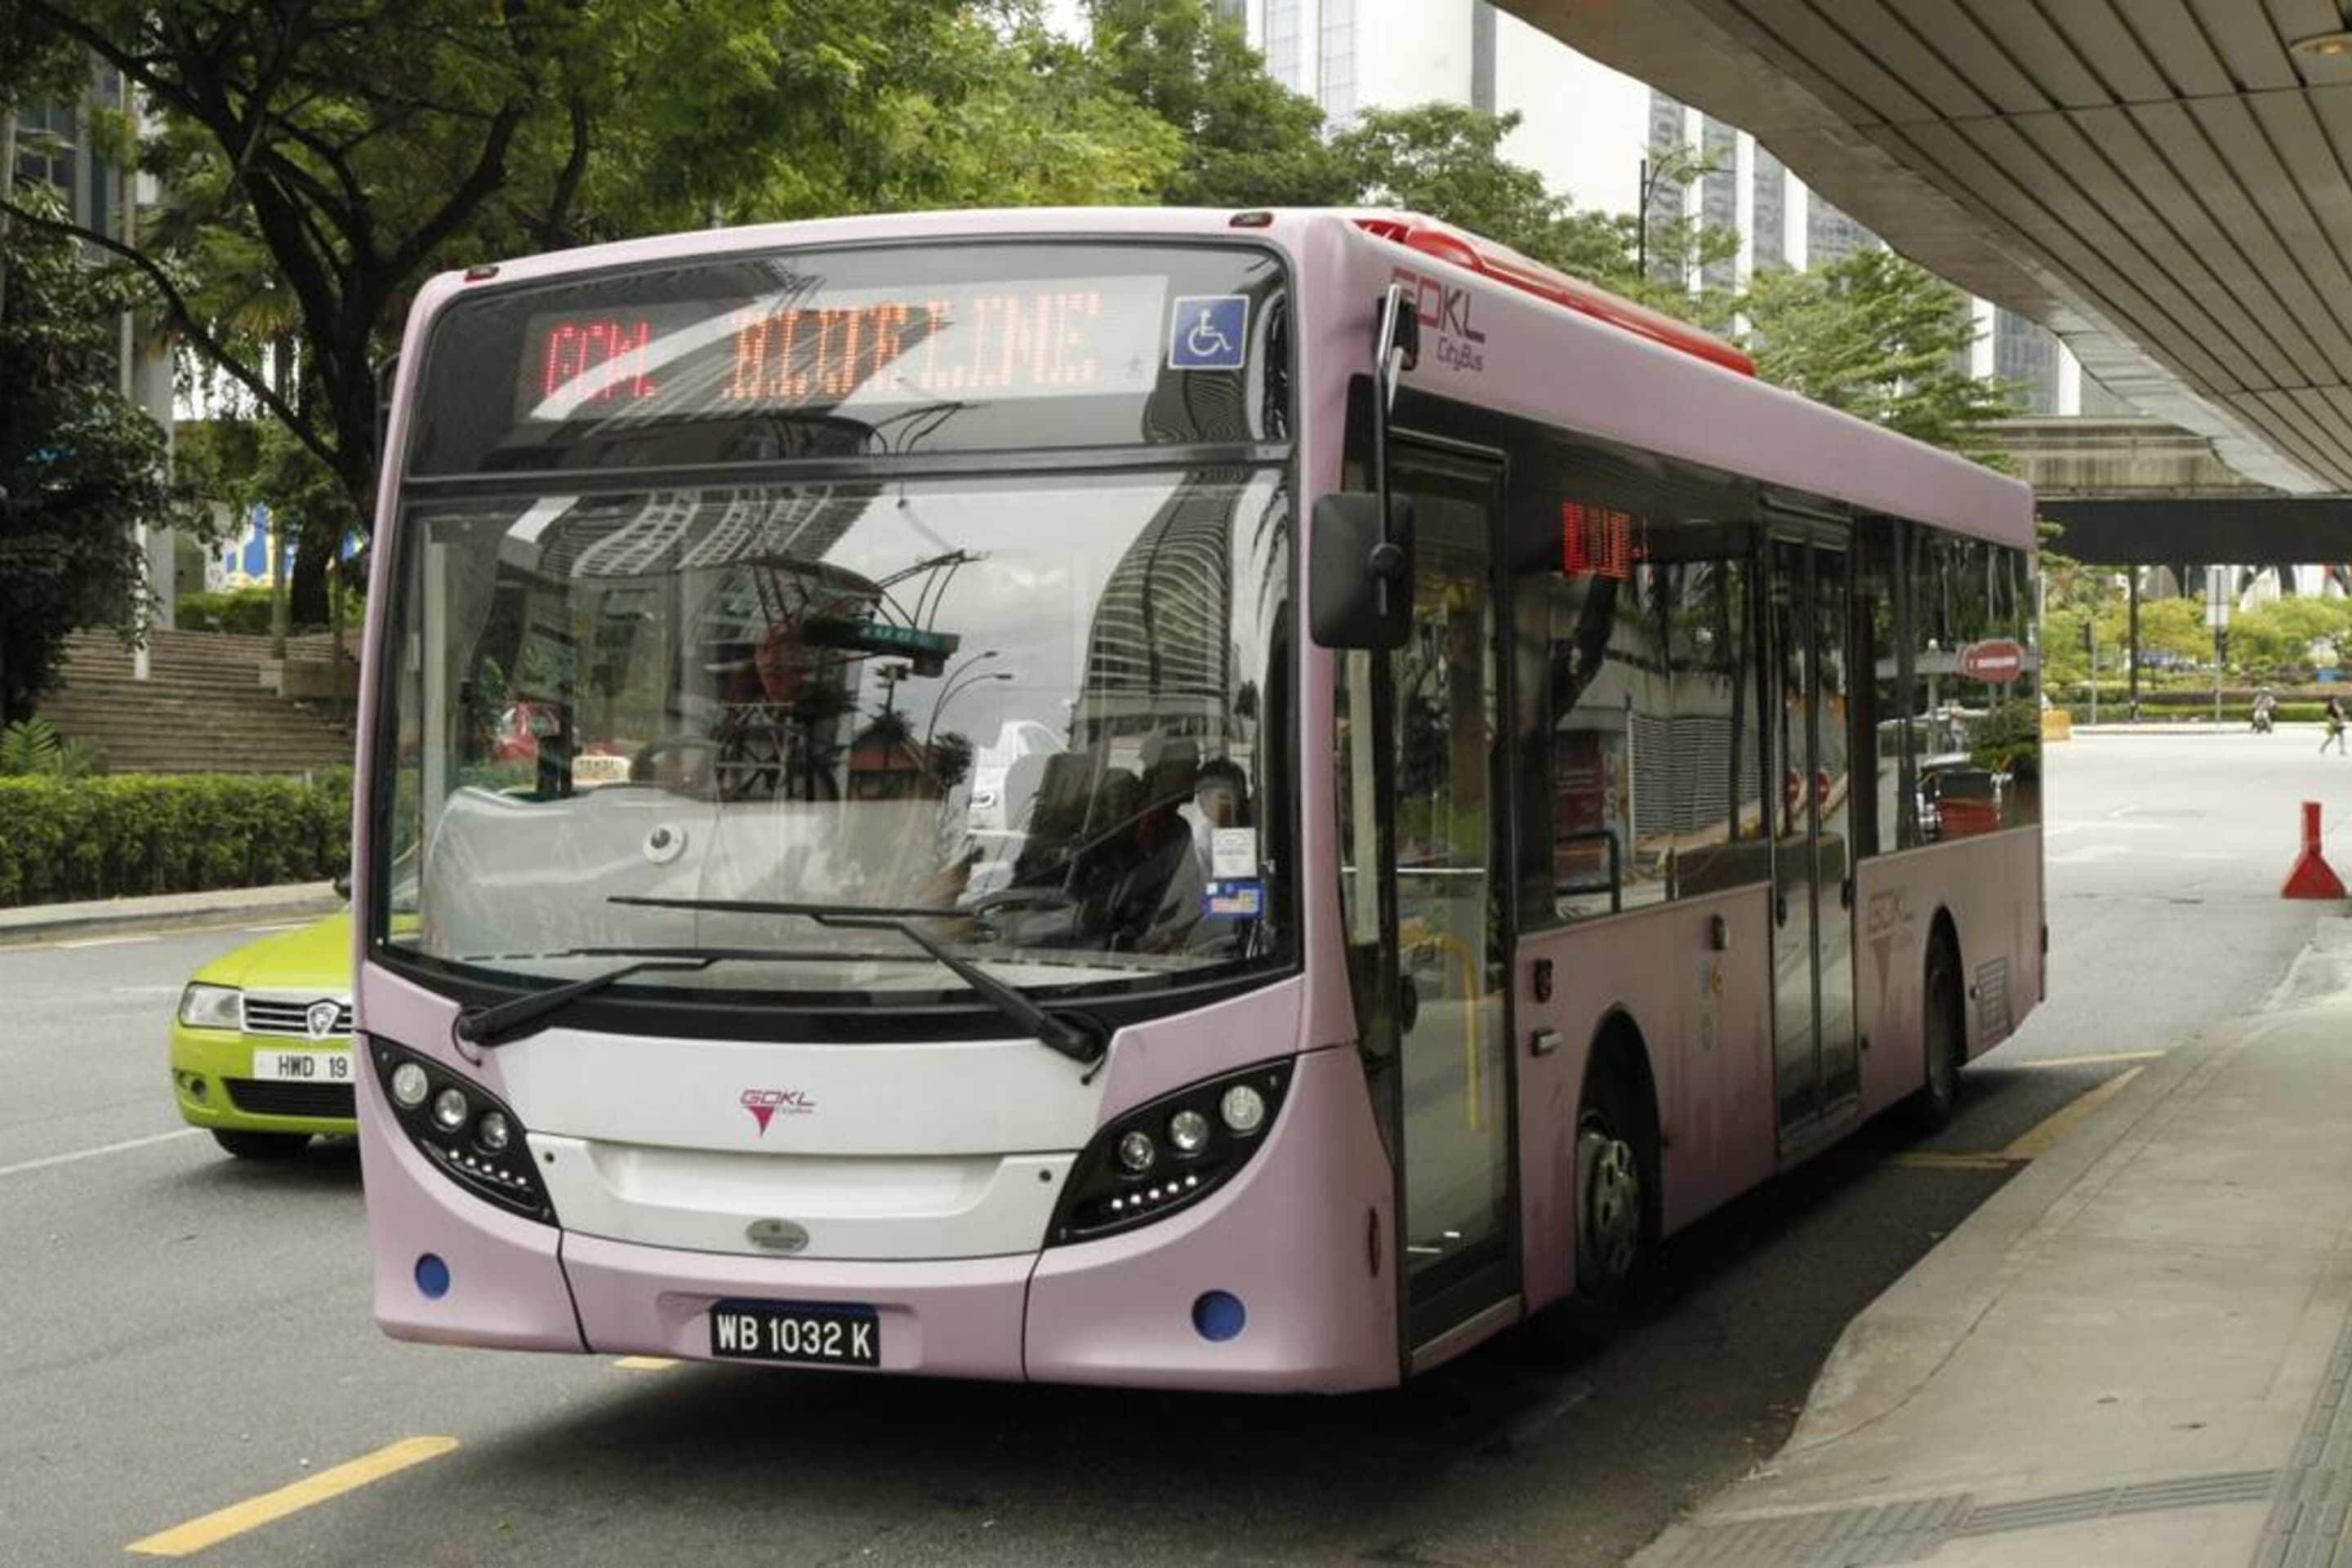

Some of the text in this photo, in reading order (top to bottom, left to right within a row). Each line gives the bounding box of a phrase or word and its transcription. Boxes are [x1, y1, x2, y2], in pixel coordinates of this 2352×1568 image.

[1437, 336, 1484, 372] CityBus
[278, 1054, 348, 1078] HWD 19
[740, 1089, 816, 1107] GOKL
[716, 1313, 871, 1359] WB 1032 K
